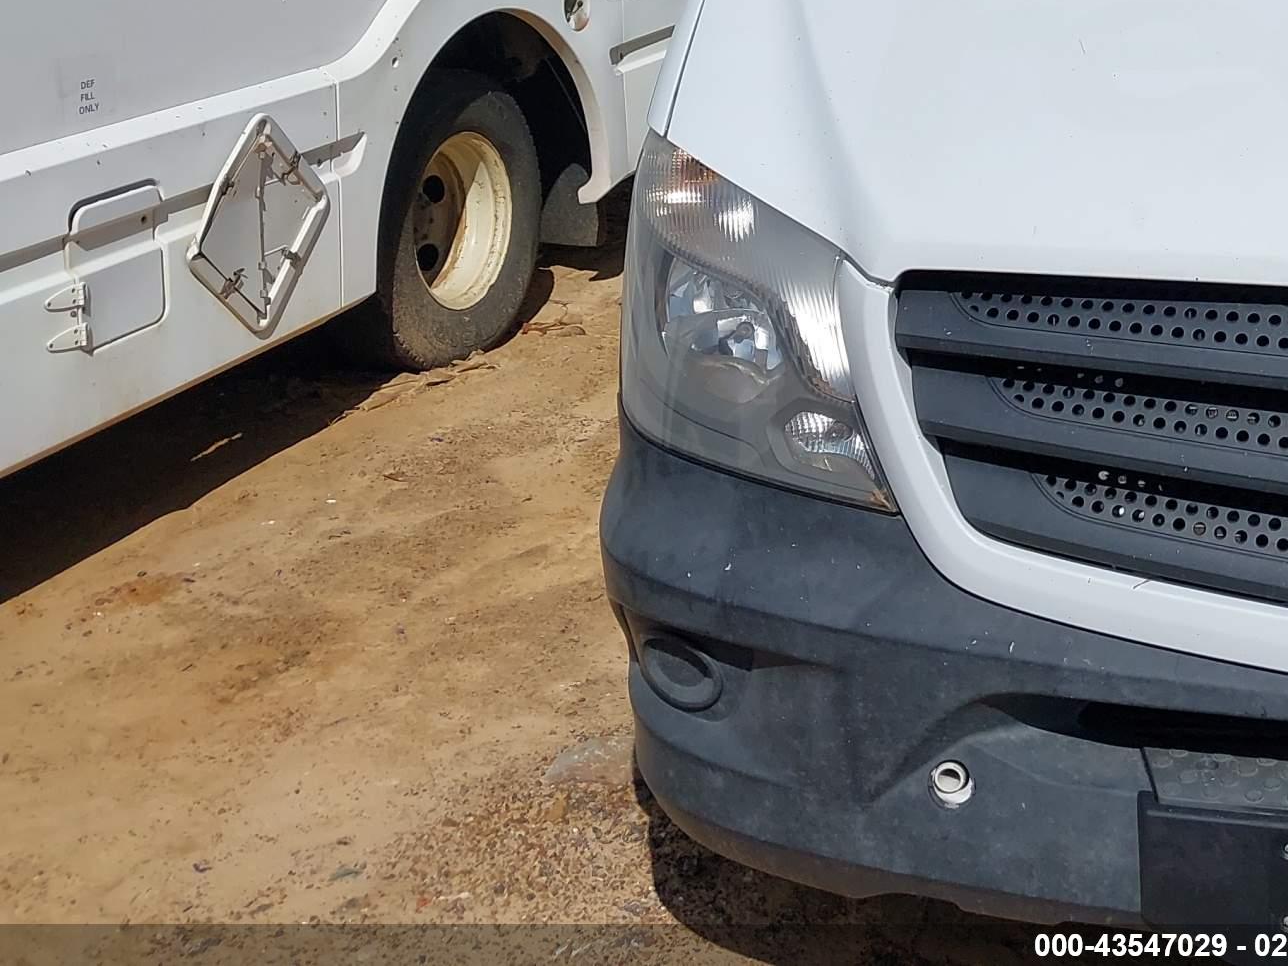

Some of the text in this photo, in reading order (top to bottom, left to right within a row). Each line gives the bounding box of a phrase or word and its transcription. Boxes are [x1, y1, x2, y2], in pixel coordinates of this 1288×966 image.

[80, 79, 95, 90] DEF
[80, 92, 95, 102] FILL
[79, 102, 100, 115] ONLY
